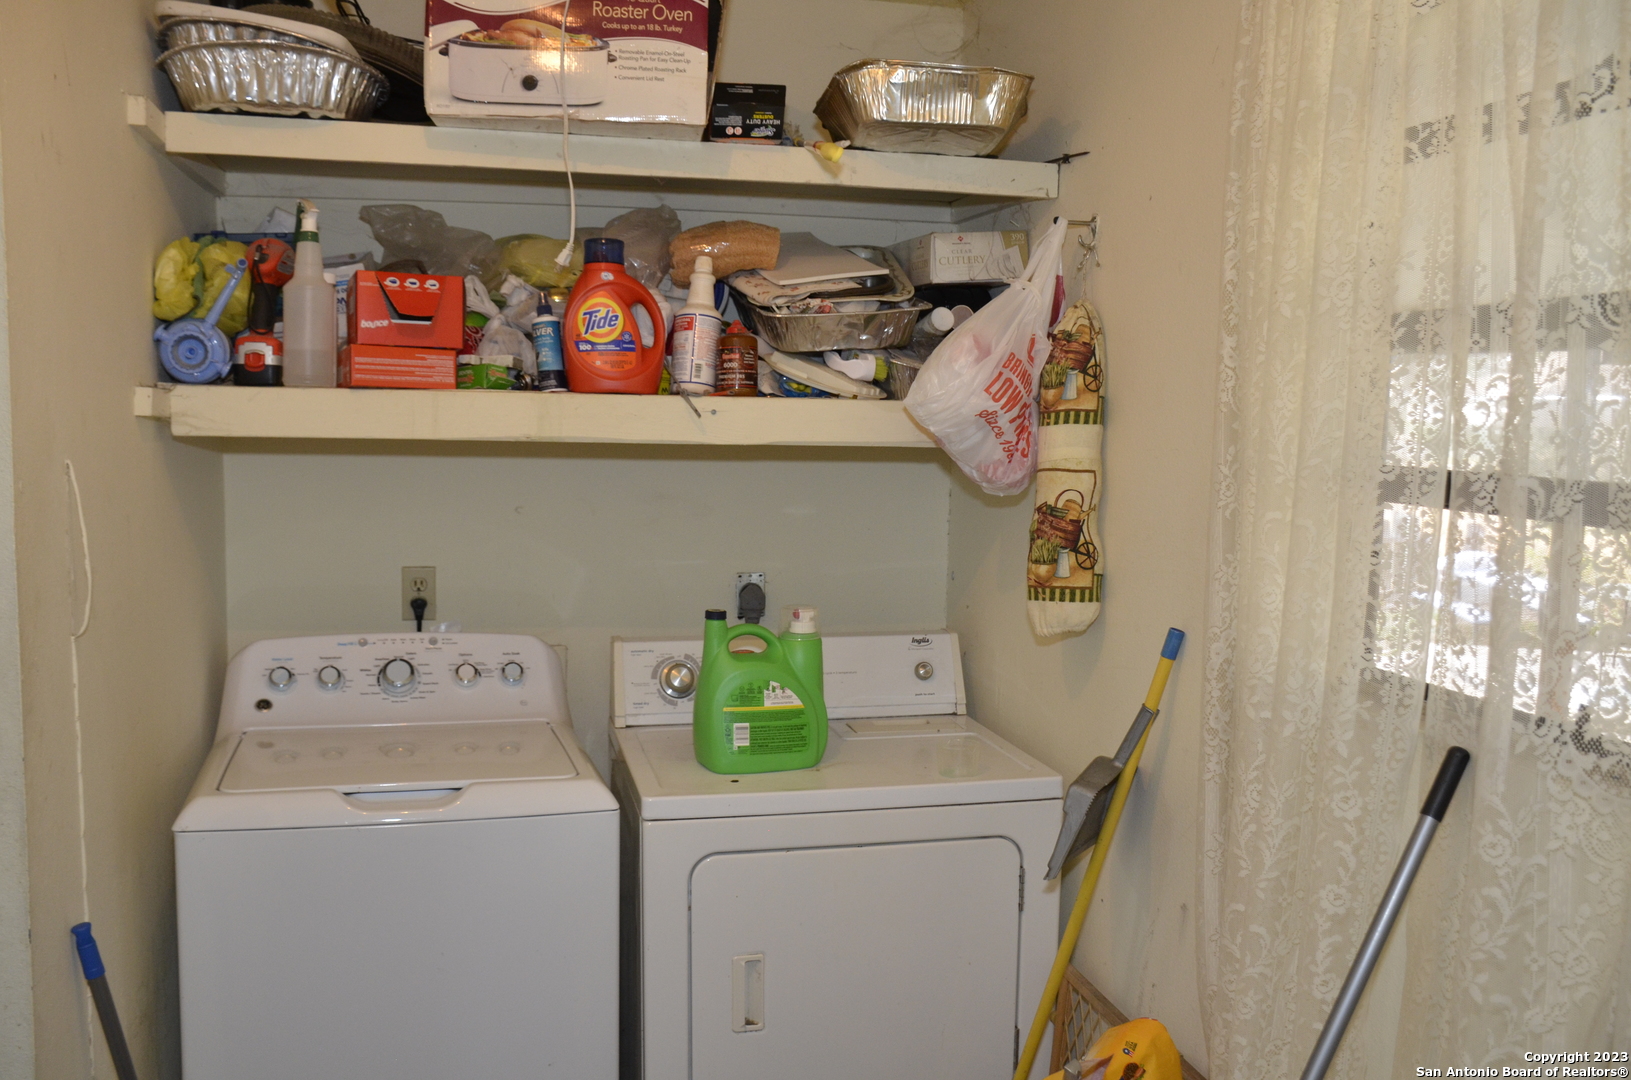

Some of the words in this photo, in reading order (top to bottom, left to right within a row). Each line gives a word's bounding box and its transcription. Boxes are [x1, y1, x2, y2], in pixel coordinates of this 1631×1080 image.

[592, 0, 649, 19] Roaster
[652, 4, 693, 21] Oven
[602, 21, 620, 29] Cooks
[663, 24, 683, 34] Turkey
[1010, 233, 1024, 241] 390
[938, 255, 986, 266] CUTLERY
[360, 319, 389, 329] bounce
[582, 307, 620, 337] Tide
[984, 370, 1024, 414] LOW
